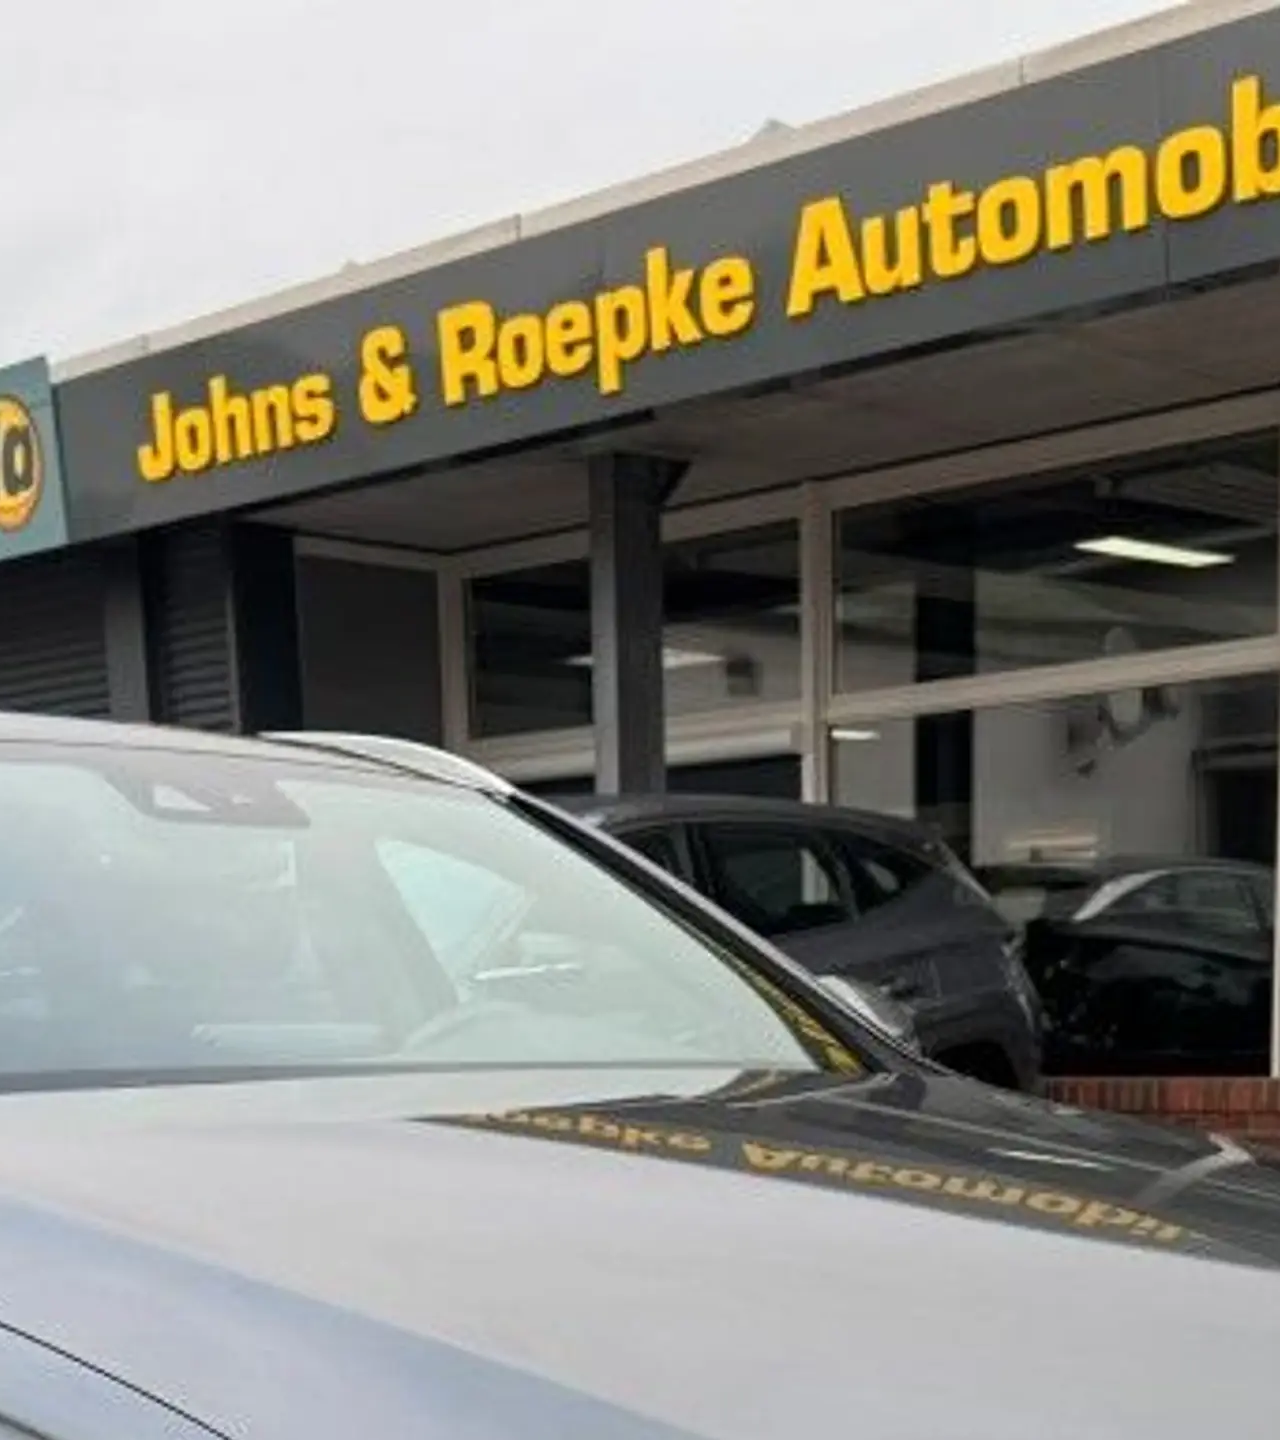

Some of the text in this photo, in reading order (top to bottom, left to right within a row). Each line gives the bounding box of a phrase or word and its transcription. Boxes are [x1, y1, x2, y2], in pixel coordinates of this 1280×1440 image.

[137, 373, 335, 482] Johns
[357, 324, 418, 424] &
[435, 245, 756, 406] Roepke
